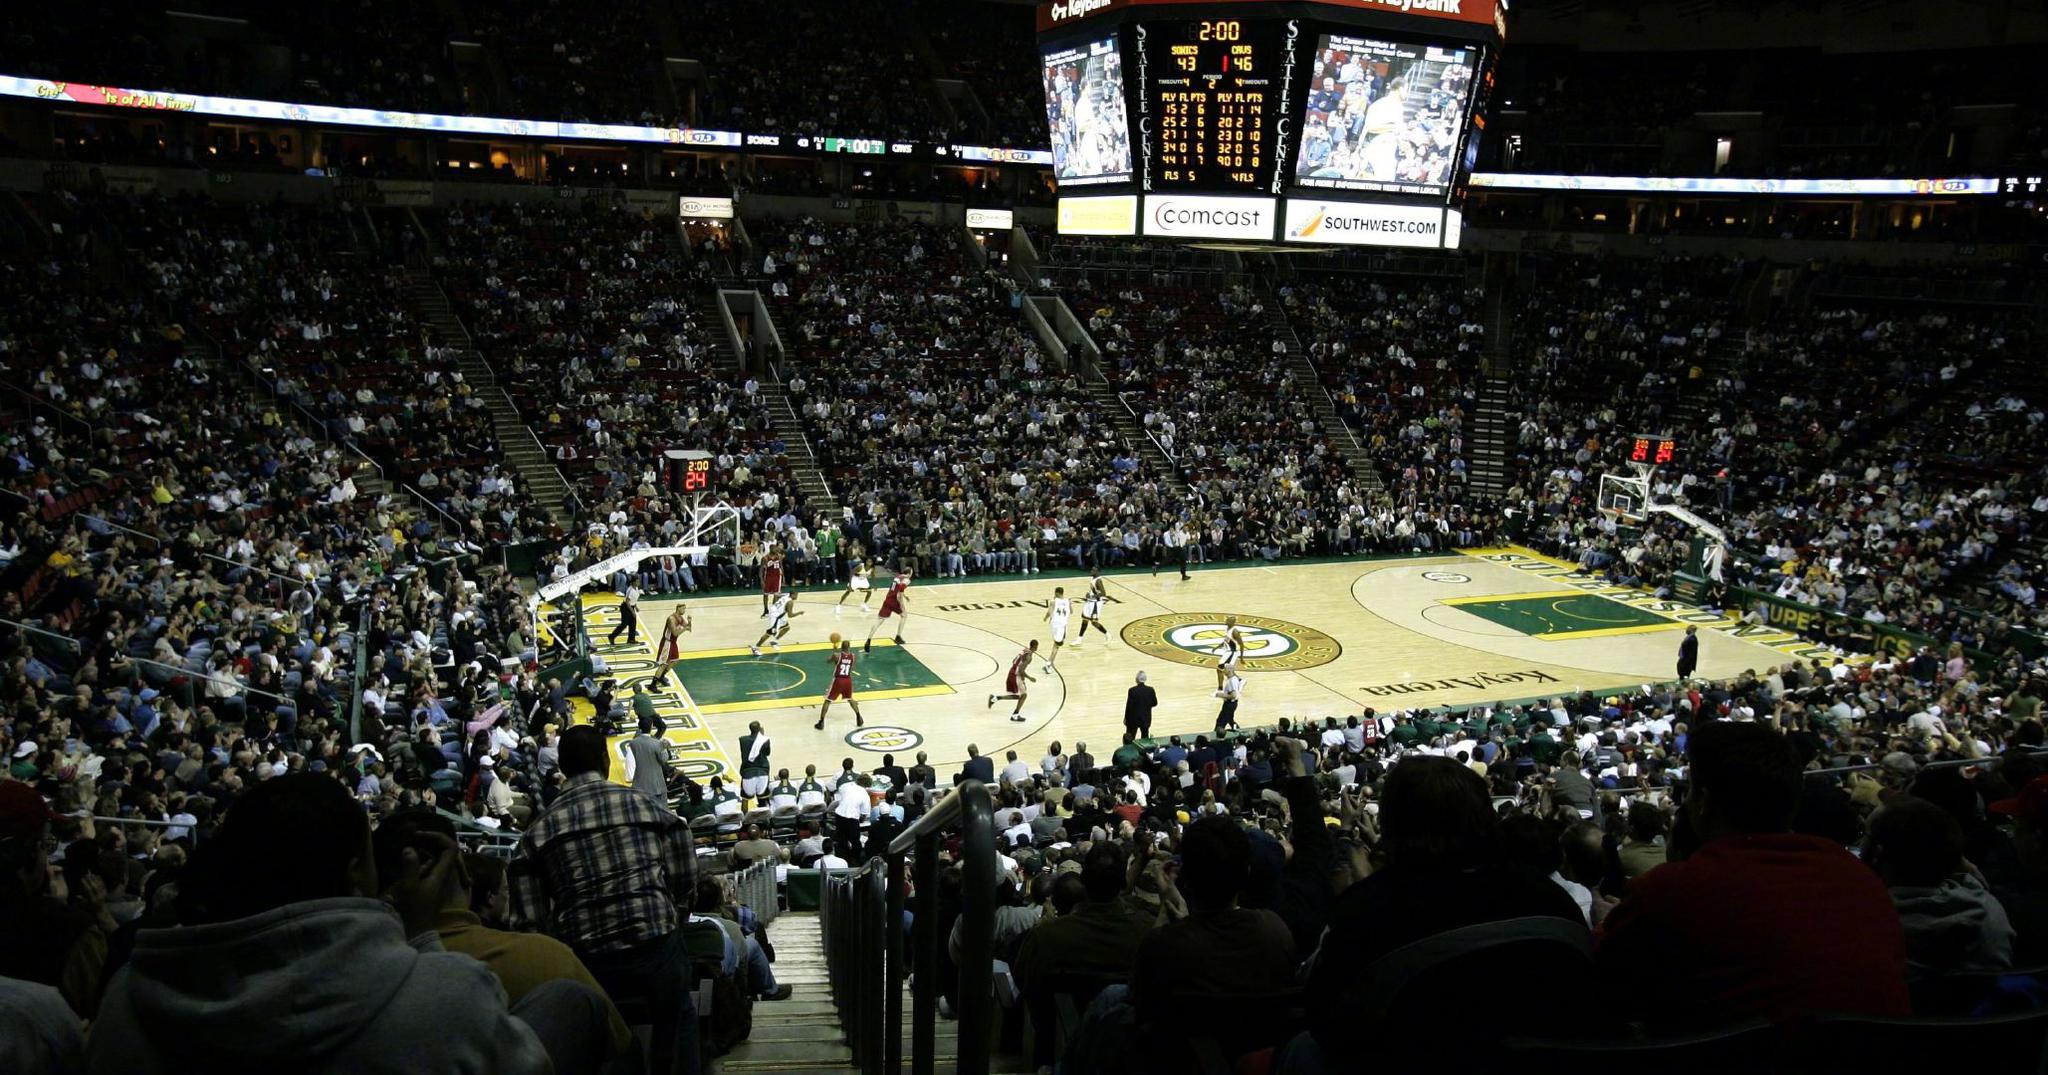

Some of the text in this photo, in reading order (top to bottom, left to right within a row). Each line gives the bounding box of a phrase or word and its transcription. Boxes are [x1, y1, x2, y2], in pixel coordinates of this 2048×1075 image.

[1377, 0, 1460, 14] eyBank
[1200, 22, 1240, 41] 2:00
[1171, 46, 1198, 55] SONICS
[1231, 45, 1252, 55] CAVS
[1177, 56, 1196, 72] 43
[1233, 57, 1252, 72] 46
[1280, 20, 1299, 114] SEATTLE
[1183, 78, 1190, 87] 4
[1208, 79, 1216, 89] 2
[1235, 78, 1243, 87] 4
[121, 92, 135, 105] of
[138, 93, 156, 108] All
[1162, 93, 1206, 102] PLY FL PTS
[1217, 93, 1263, 102] PLY FL PTS
[1166, 104, 1205, 115] 15 2 6
[1222, 105, 1261, 114] 11 1 14
[1162, 117, 1205, 127] 25 2 6
[1218, 117, 1261, 128] 20 2 3
[747, 135, 780, 145] SONICS
[1162, 130, 1205, 140] 27 1 4
[1218, 130, 1261, 141] 23 0 10
[836, 138, 870, 153] 2:00
[1163, 142, 1204, 153] 34 0 6
[1218, 143, 1260, 154] 32 0 5
[1139, 117, 1152, 191] CENTER
[1272, 118, 1290, 194] CENTER
[1162, 155, 1204, 165] 44 1 7
[1217, 156, 1260, 167] 90 0 8
[1164, 171, 1196, 181] FLS 5
[1232, 173, 1254, 182] 4 FLS
[1325, 216, 1436, 234] SOUTHWEST.COM
[688, 460, 709, 472] 2:00
[686, 472, 706, 490] 24
[1359, 670, 1562, 696] KeyArena
[1366, 728, 1375, 738] 23
